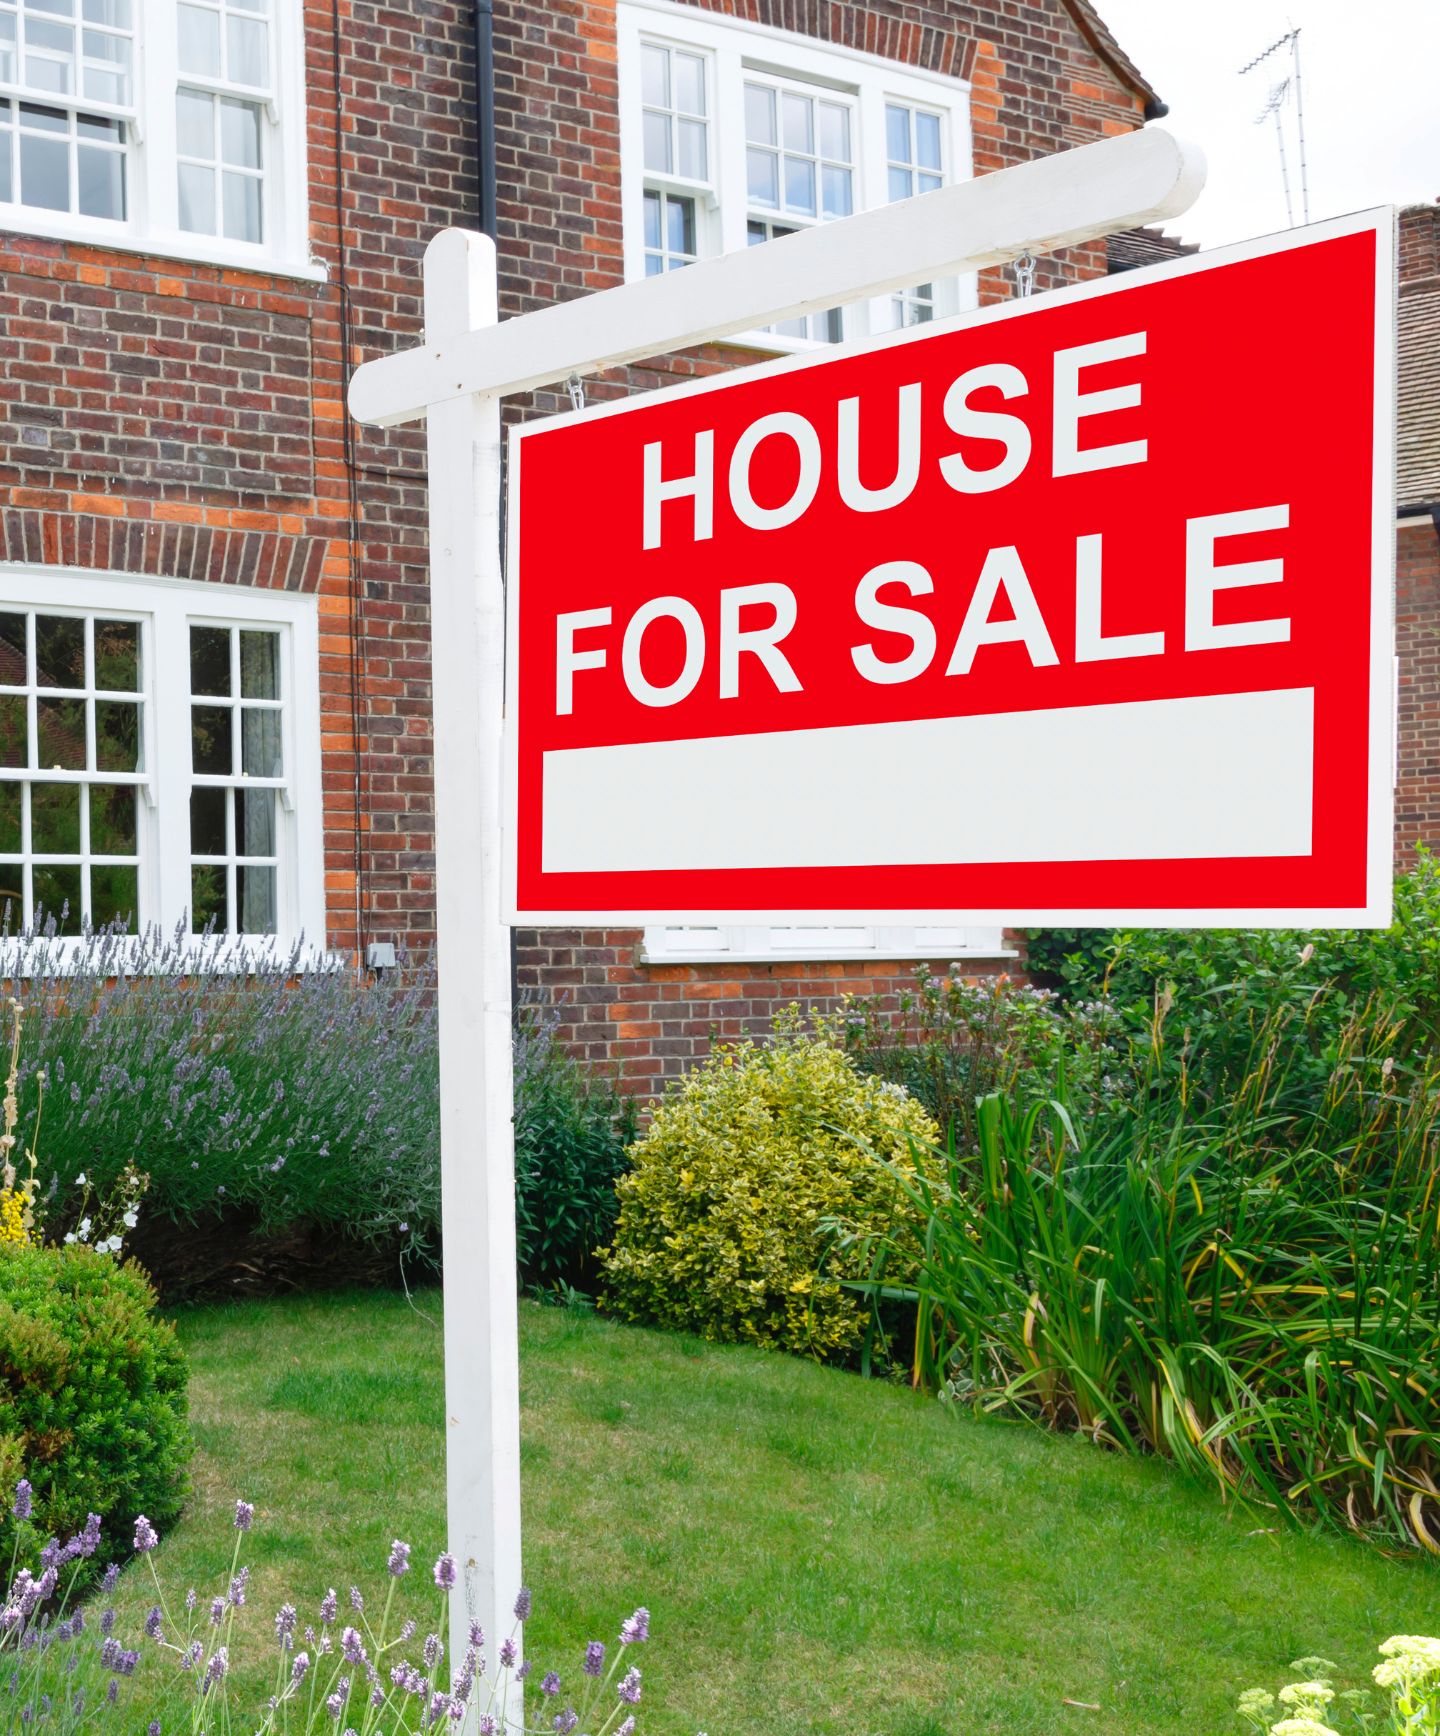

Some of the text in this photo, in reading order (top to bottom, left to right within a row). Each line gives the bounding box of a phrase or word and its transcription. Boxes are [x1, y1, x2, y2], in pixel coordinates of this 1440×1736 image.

[643, 331, 1148, 550] HOUSE
[556, 503, 1292, 716] FOR SALE
